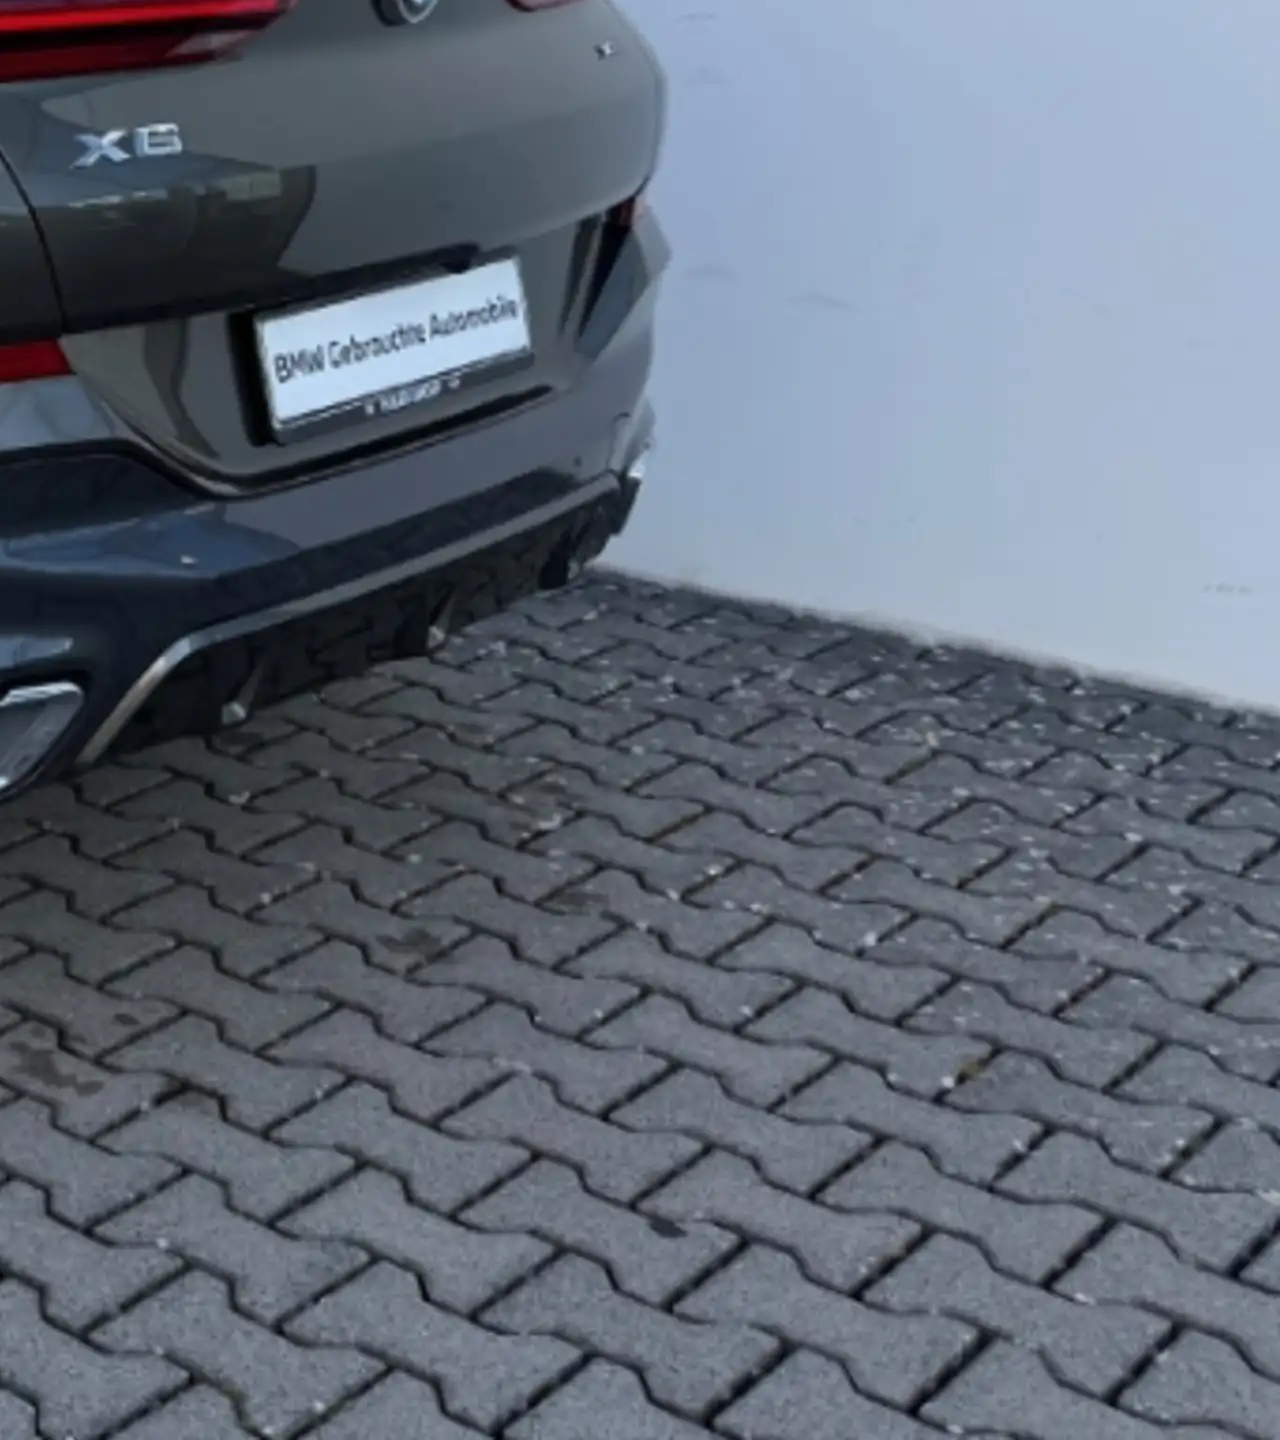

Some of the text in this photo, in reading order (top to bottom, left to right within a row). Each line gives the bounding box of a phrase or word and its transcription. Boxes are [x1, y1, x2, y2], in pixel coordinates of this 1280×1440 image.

[69, 123, 183, 169] X6
[274, 345, 325, 383] BMW
[328, 319, 426, 367] Gebrauchte
